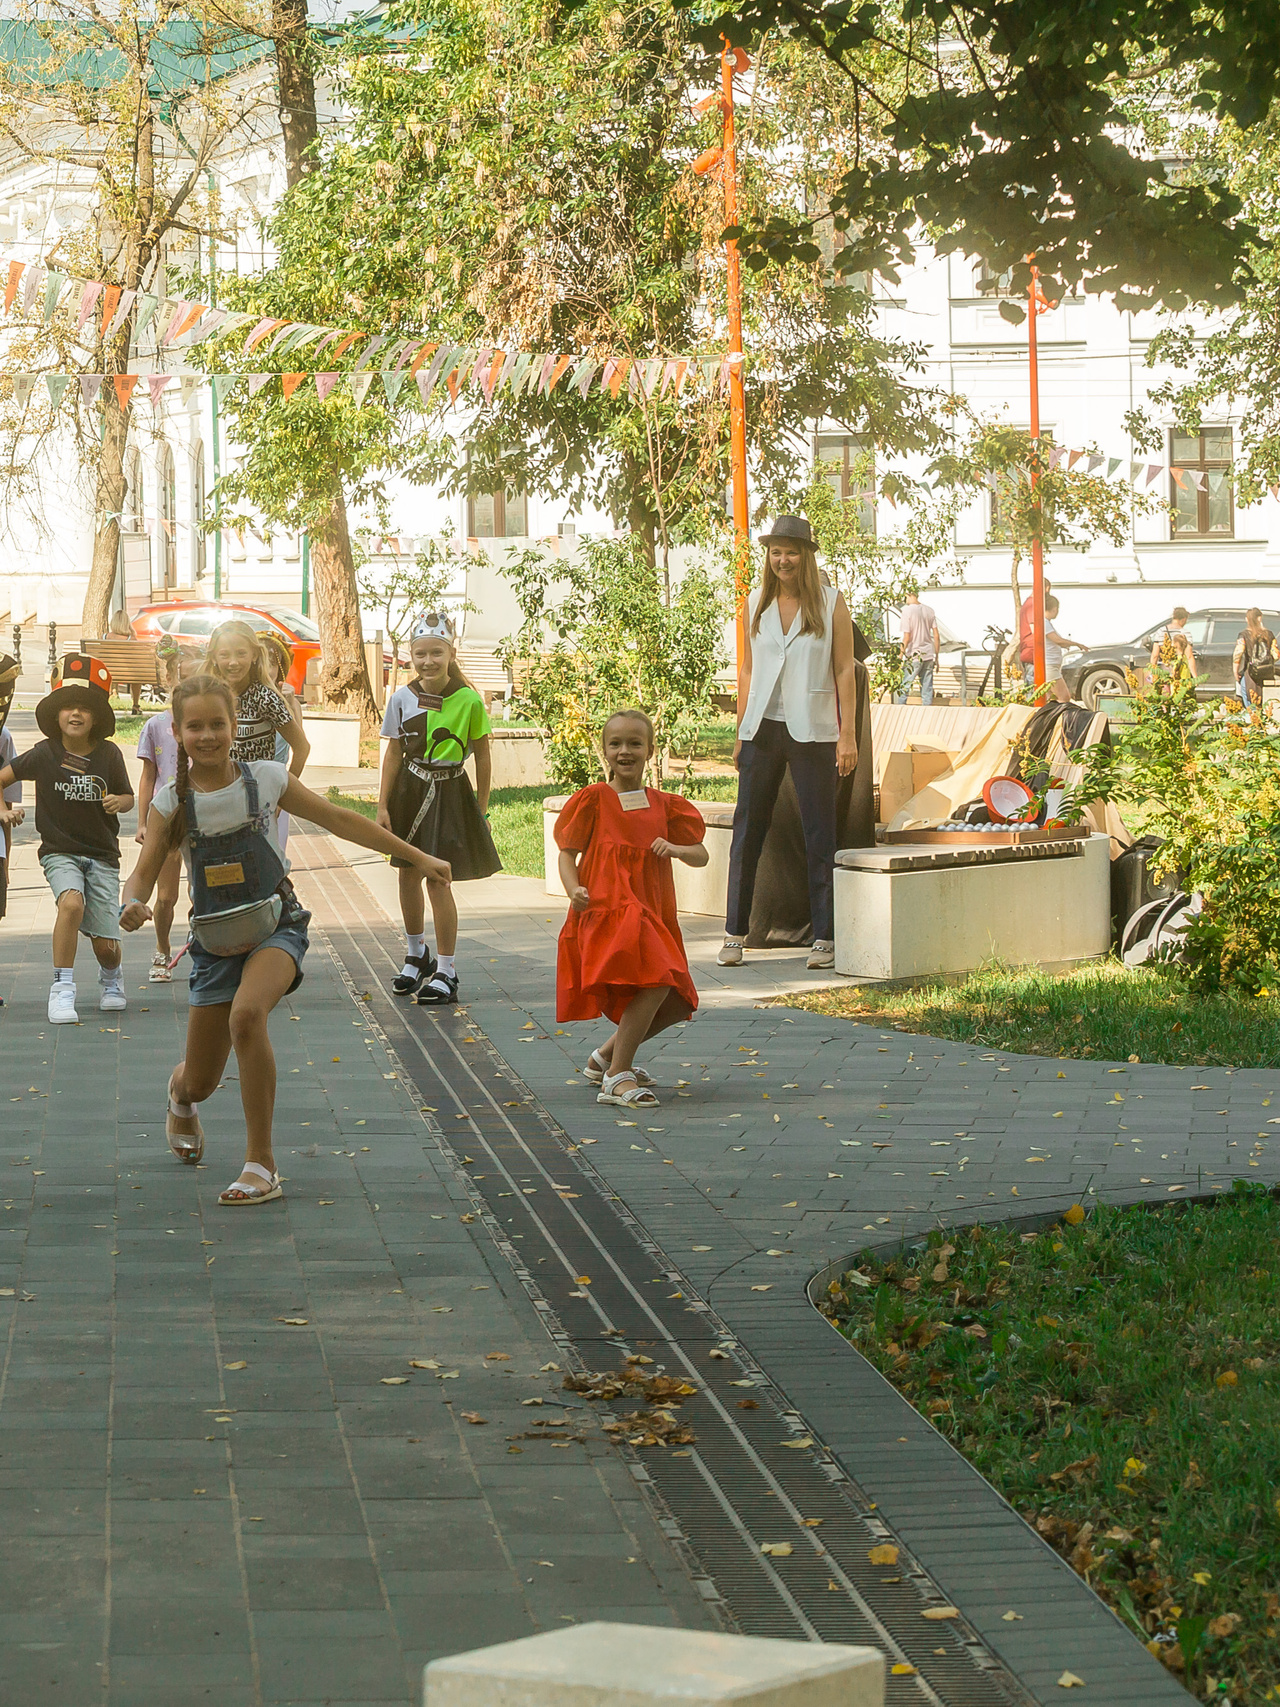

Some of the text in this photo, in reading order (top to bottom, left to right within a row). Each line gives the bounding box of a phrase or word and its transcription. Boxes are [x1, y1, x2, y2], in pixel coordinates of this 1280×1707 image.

[237, 727, 255, 737] DIOR
[70, 775, 91, 785] THE
[54, 782, 91, 793] NORTH
[64, 792, 91, 801] FACE
